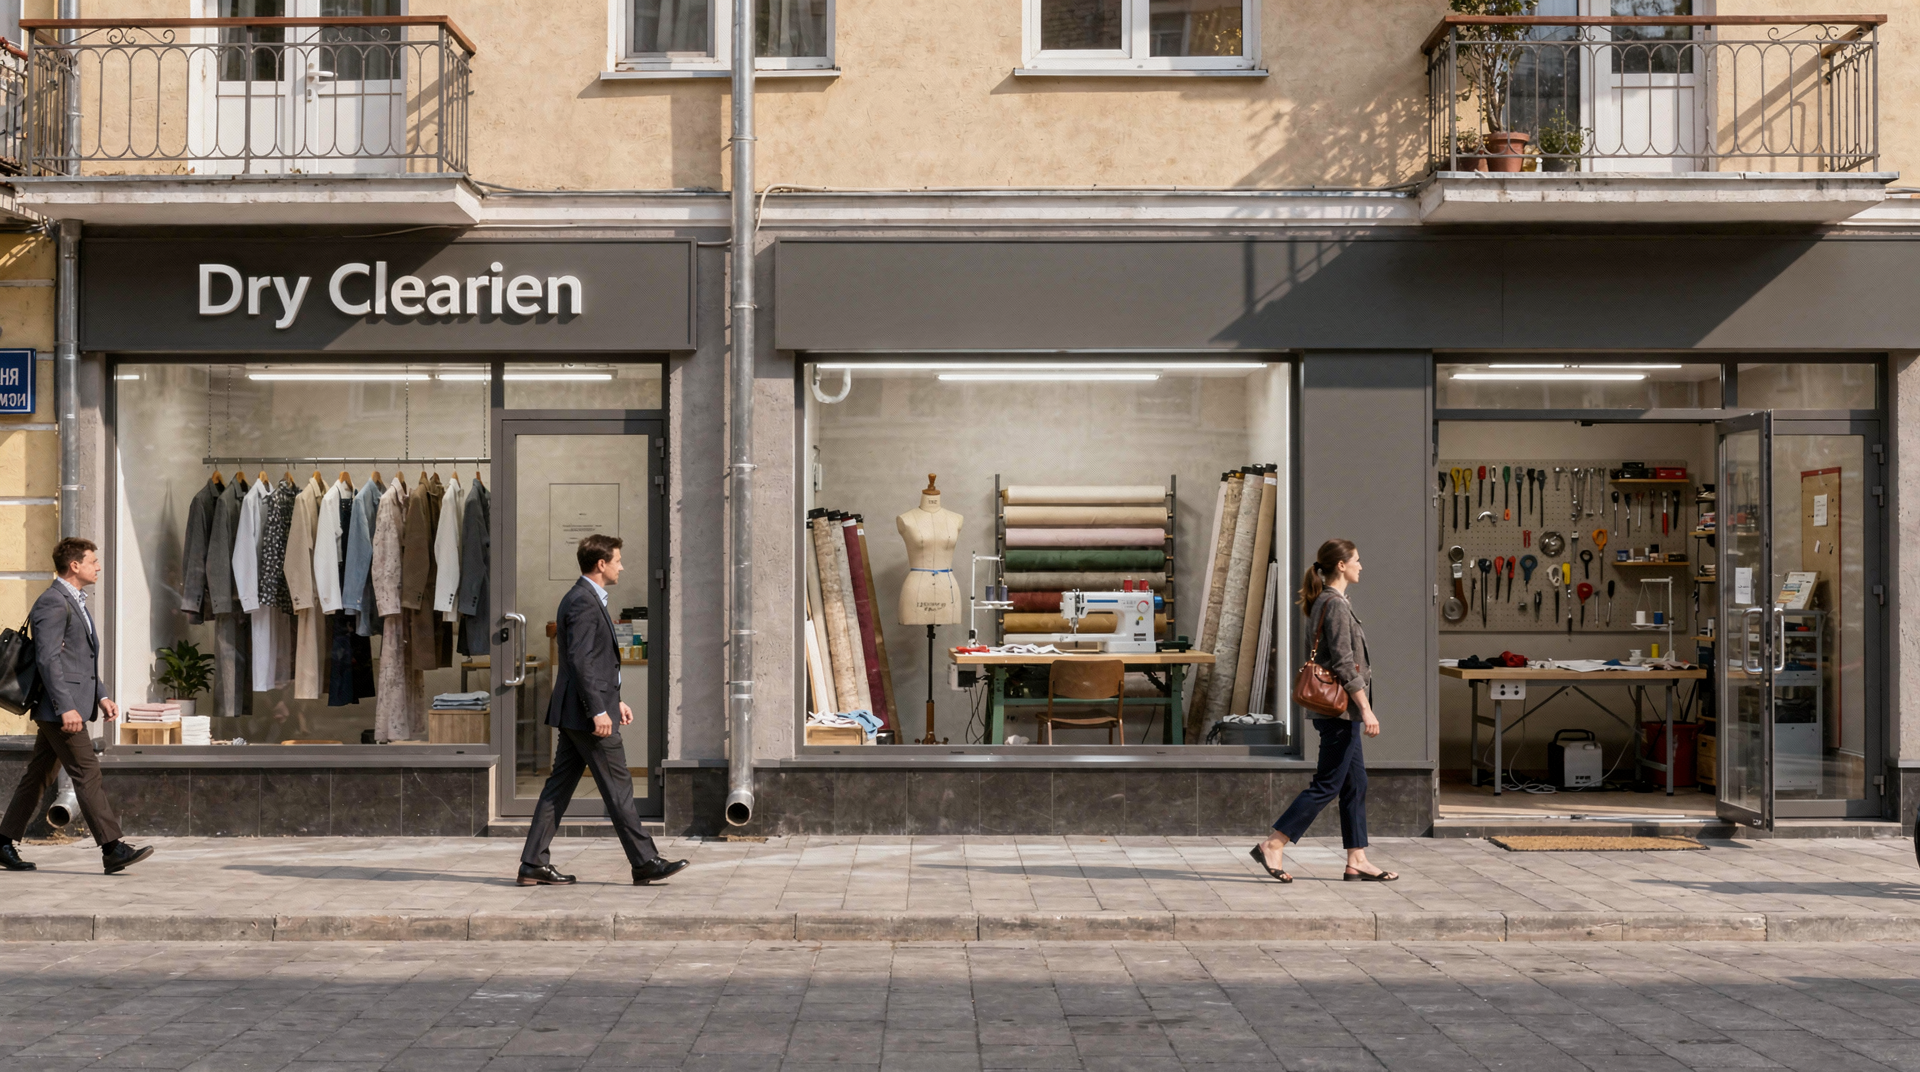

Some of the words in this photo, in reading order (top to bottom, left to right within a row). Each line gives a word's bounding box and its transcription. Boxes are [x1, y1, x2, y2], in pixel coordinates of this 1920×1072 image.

[199, 263, 312, 329] Dry
[328, 261, 582, 316] Clearien
[0, 367, 19, 386] НЯ
